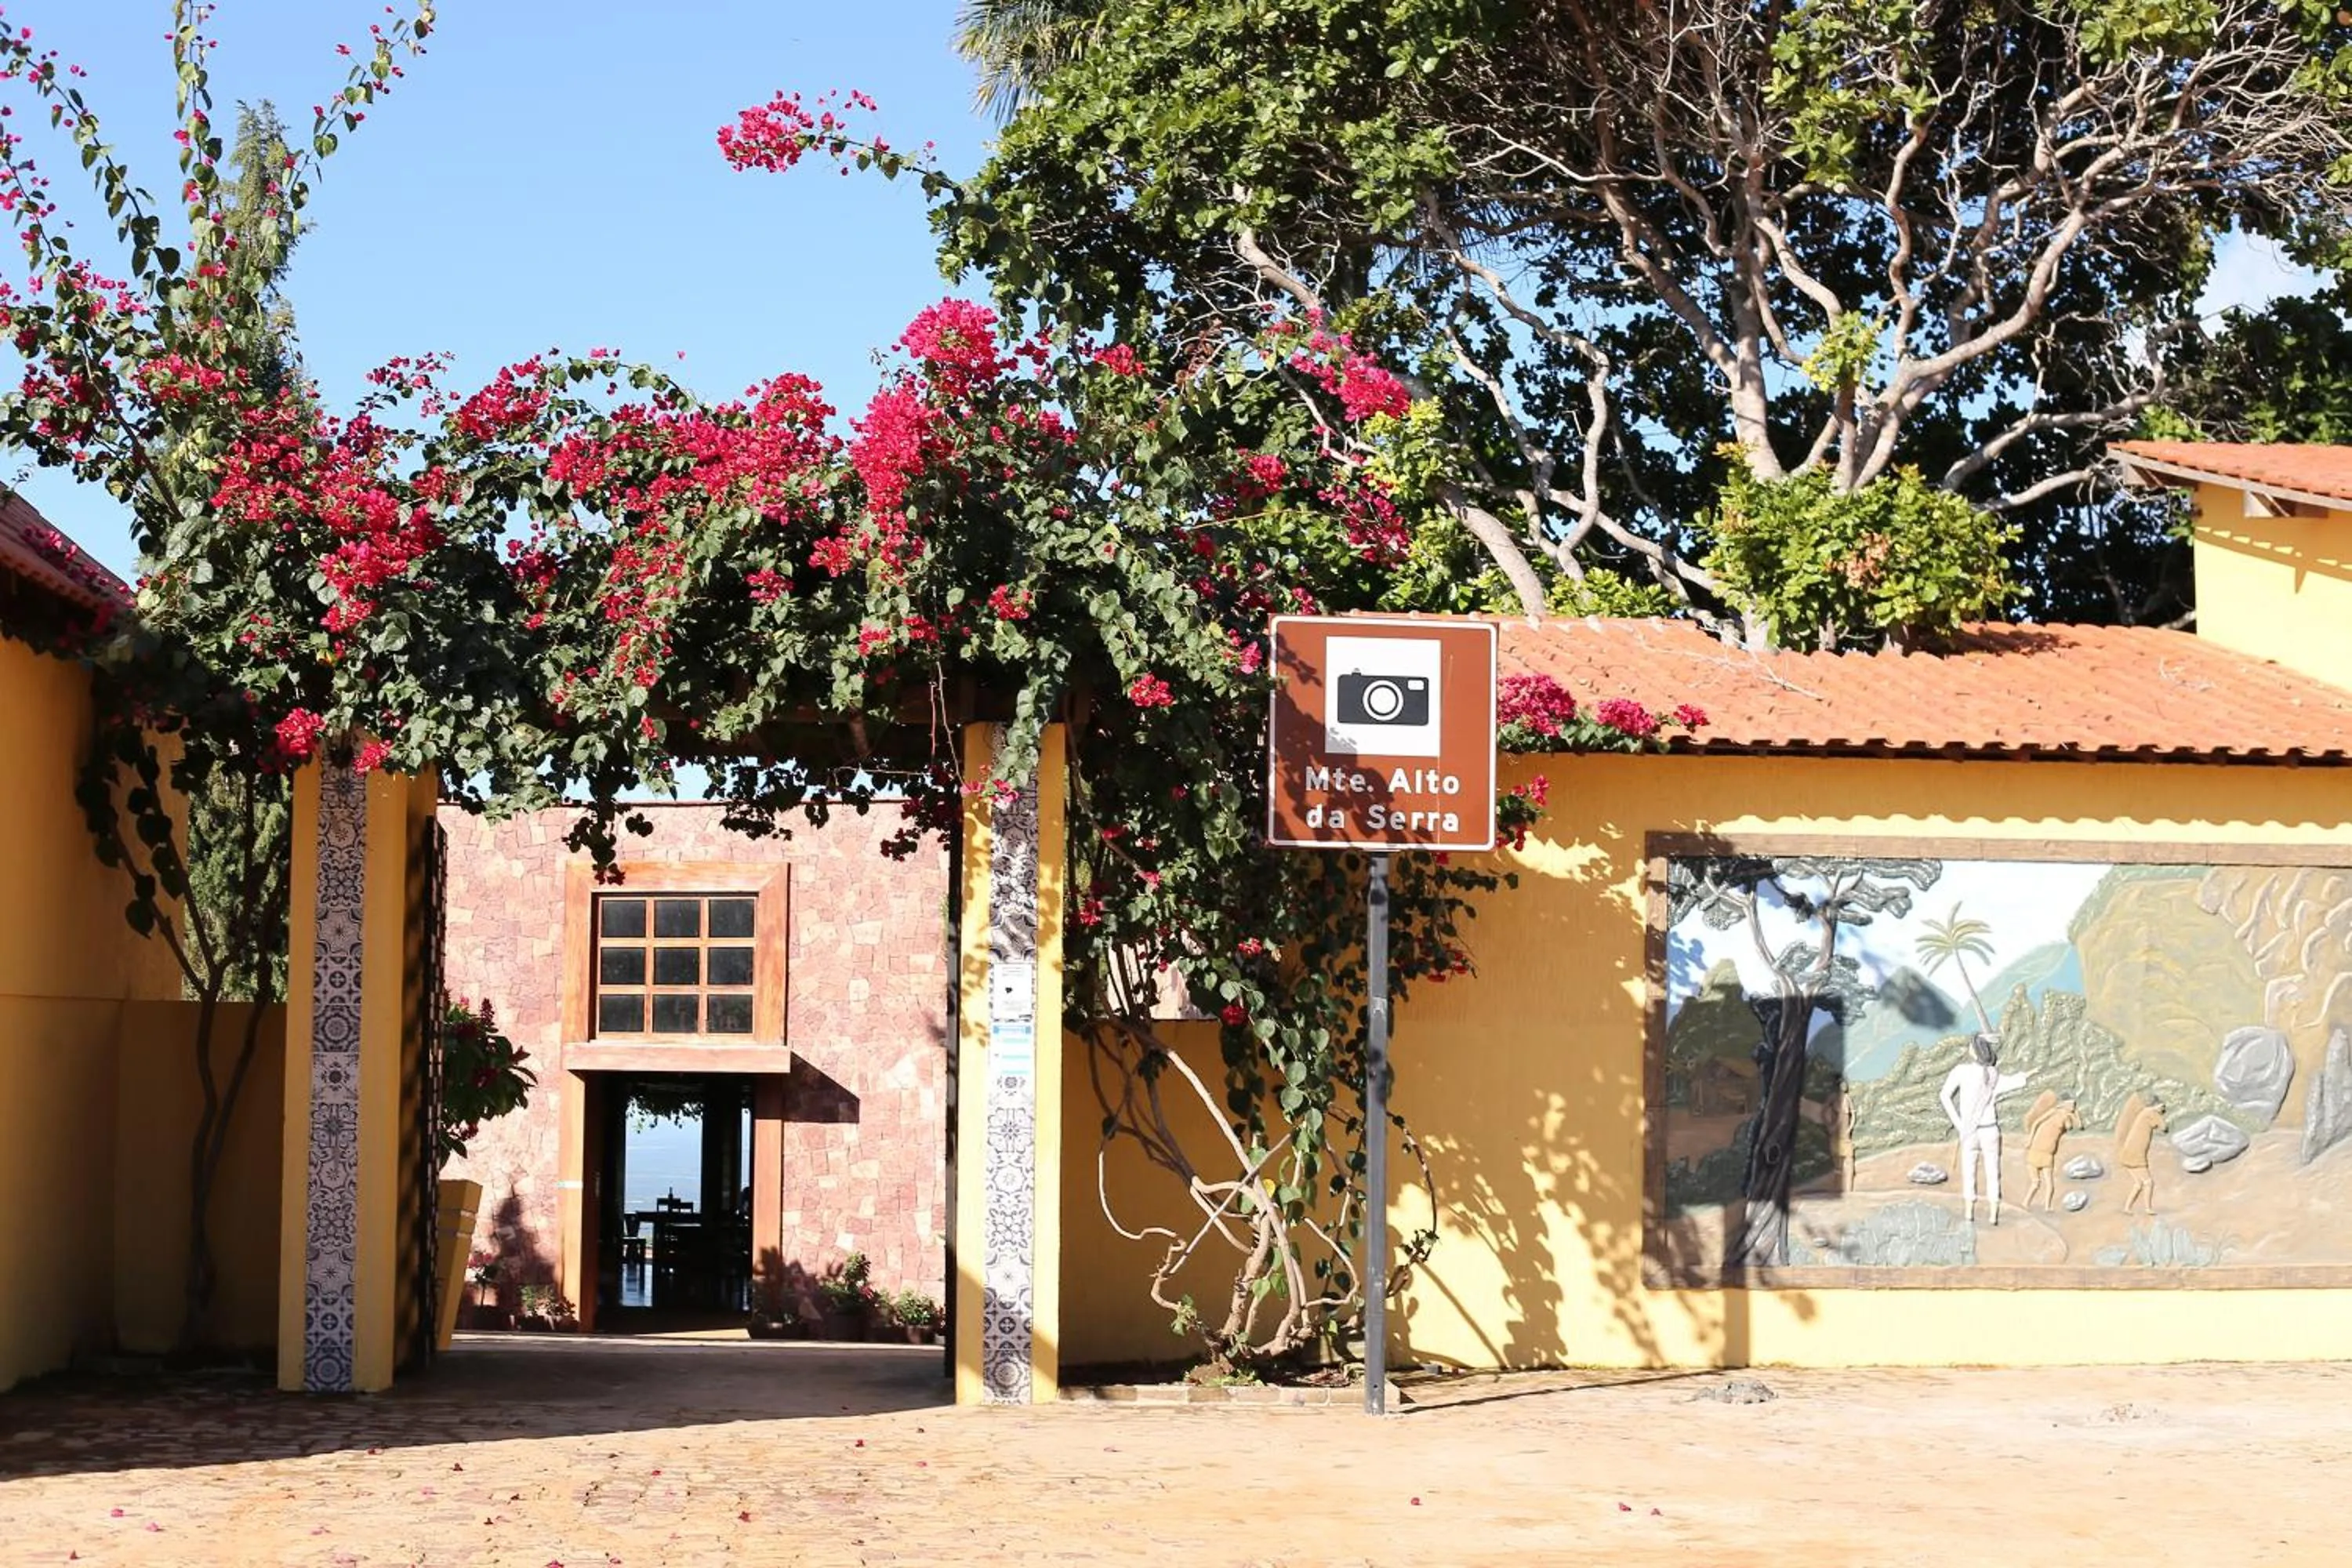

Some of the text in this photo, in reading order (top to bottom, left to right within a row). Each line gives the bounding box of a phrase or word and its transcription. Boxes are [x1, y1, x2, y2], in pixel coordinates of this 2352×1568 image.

[1305, 765, 1461, 794] Mte. Alto
[1305, 803, 1459, 832] da Serra
